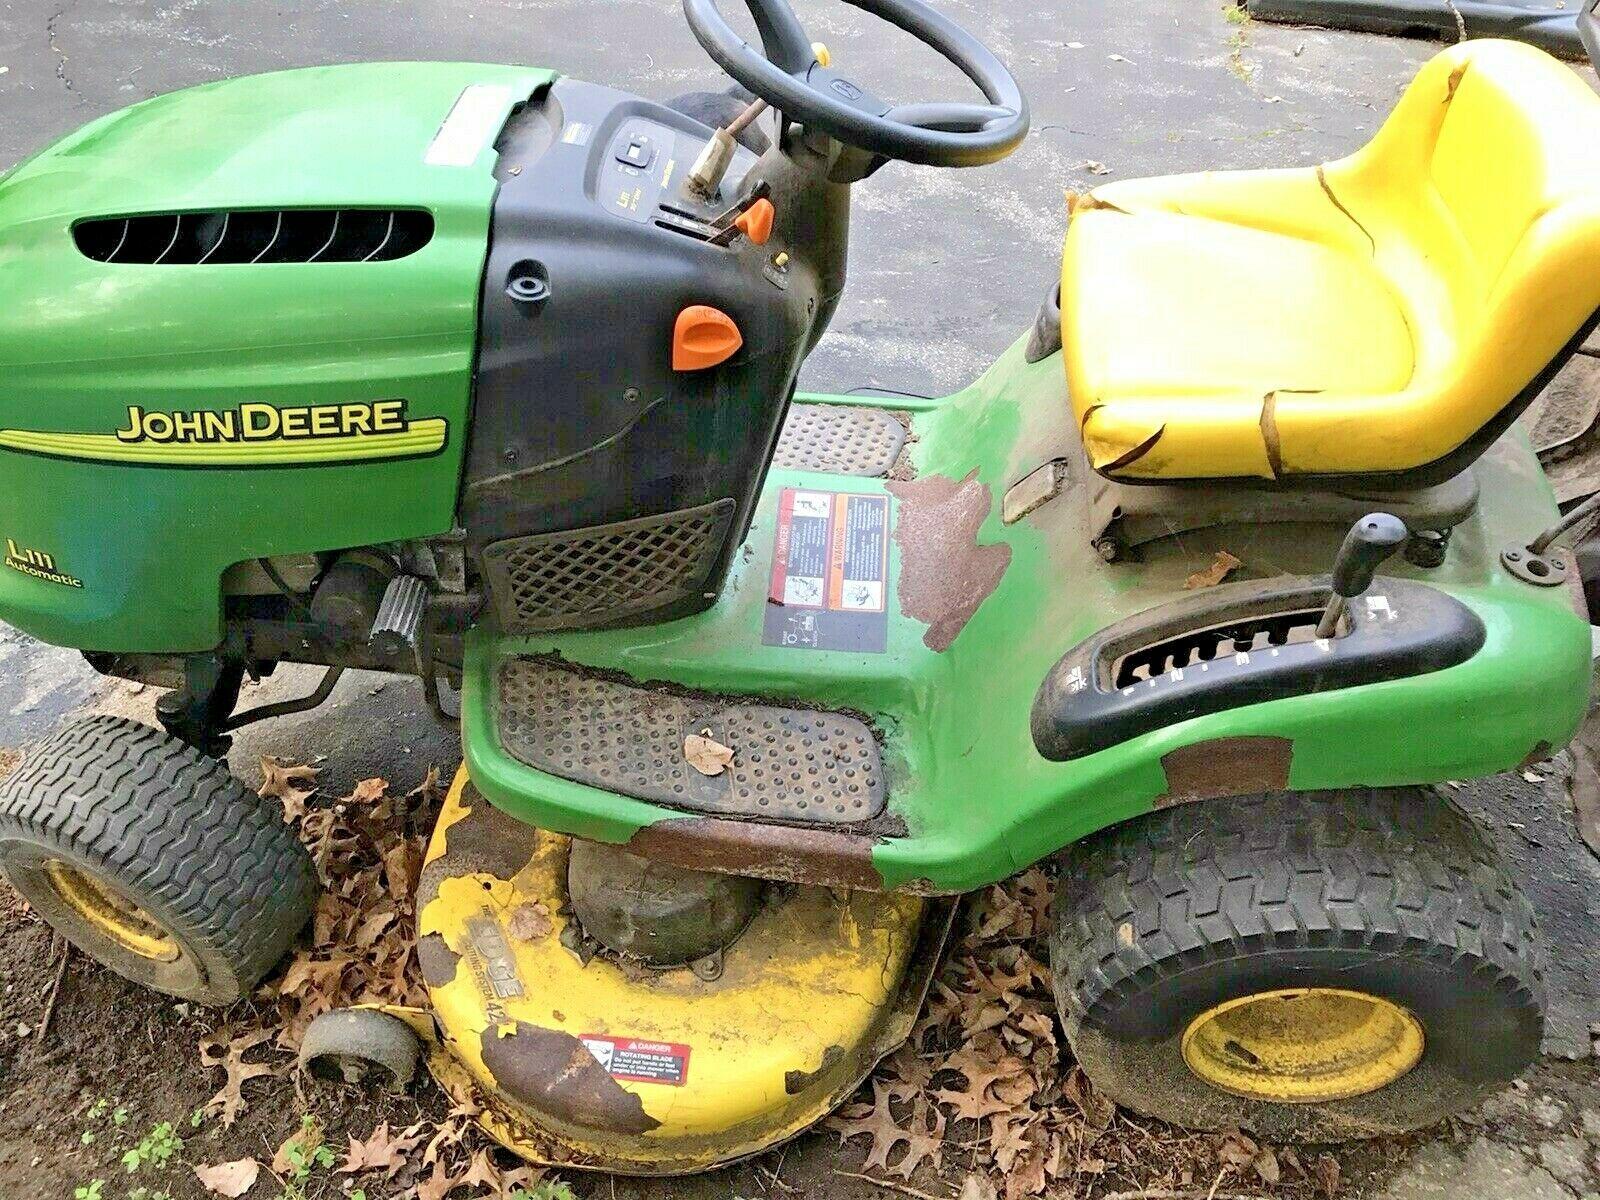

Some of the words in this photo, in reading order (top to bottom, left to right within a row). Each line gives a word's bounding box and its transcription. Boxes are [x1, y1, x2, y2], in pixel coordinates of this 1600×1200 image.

[116, 405, 237, 442] JOHN
[239, 400, 407, 440] DEERE
[7, 538, 54, 570] L111
[776, 525, 789, 561] DANGER
[833, 527, 844, 562] WARNING
[5, 556, 84, 588] Automatic
[463, 917, 525, 1000] DGE
[463, 943, 482, 971] UTTING
[475, 969, 495, 1001] SYSTEM
[486, 1001, 507, 1025] 42
[620, 1051, 651, 1060] ROTATING
[652, 1054, 674, 1062] BLADE
[637, 1042, 672, 1053] DANGER
